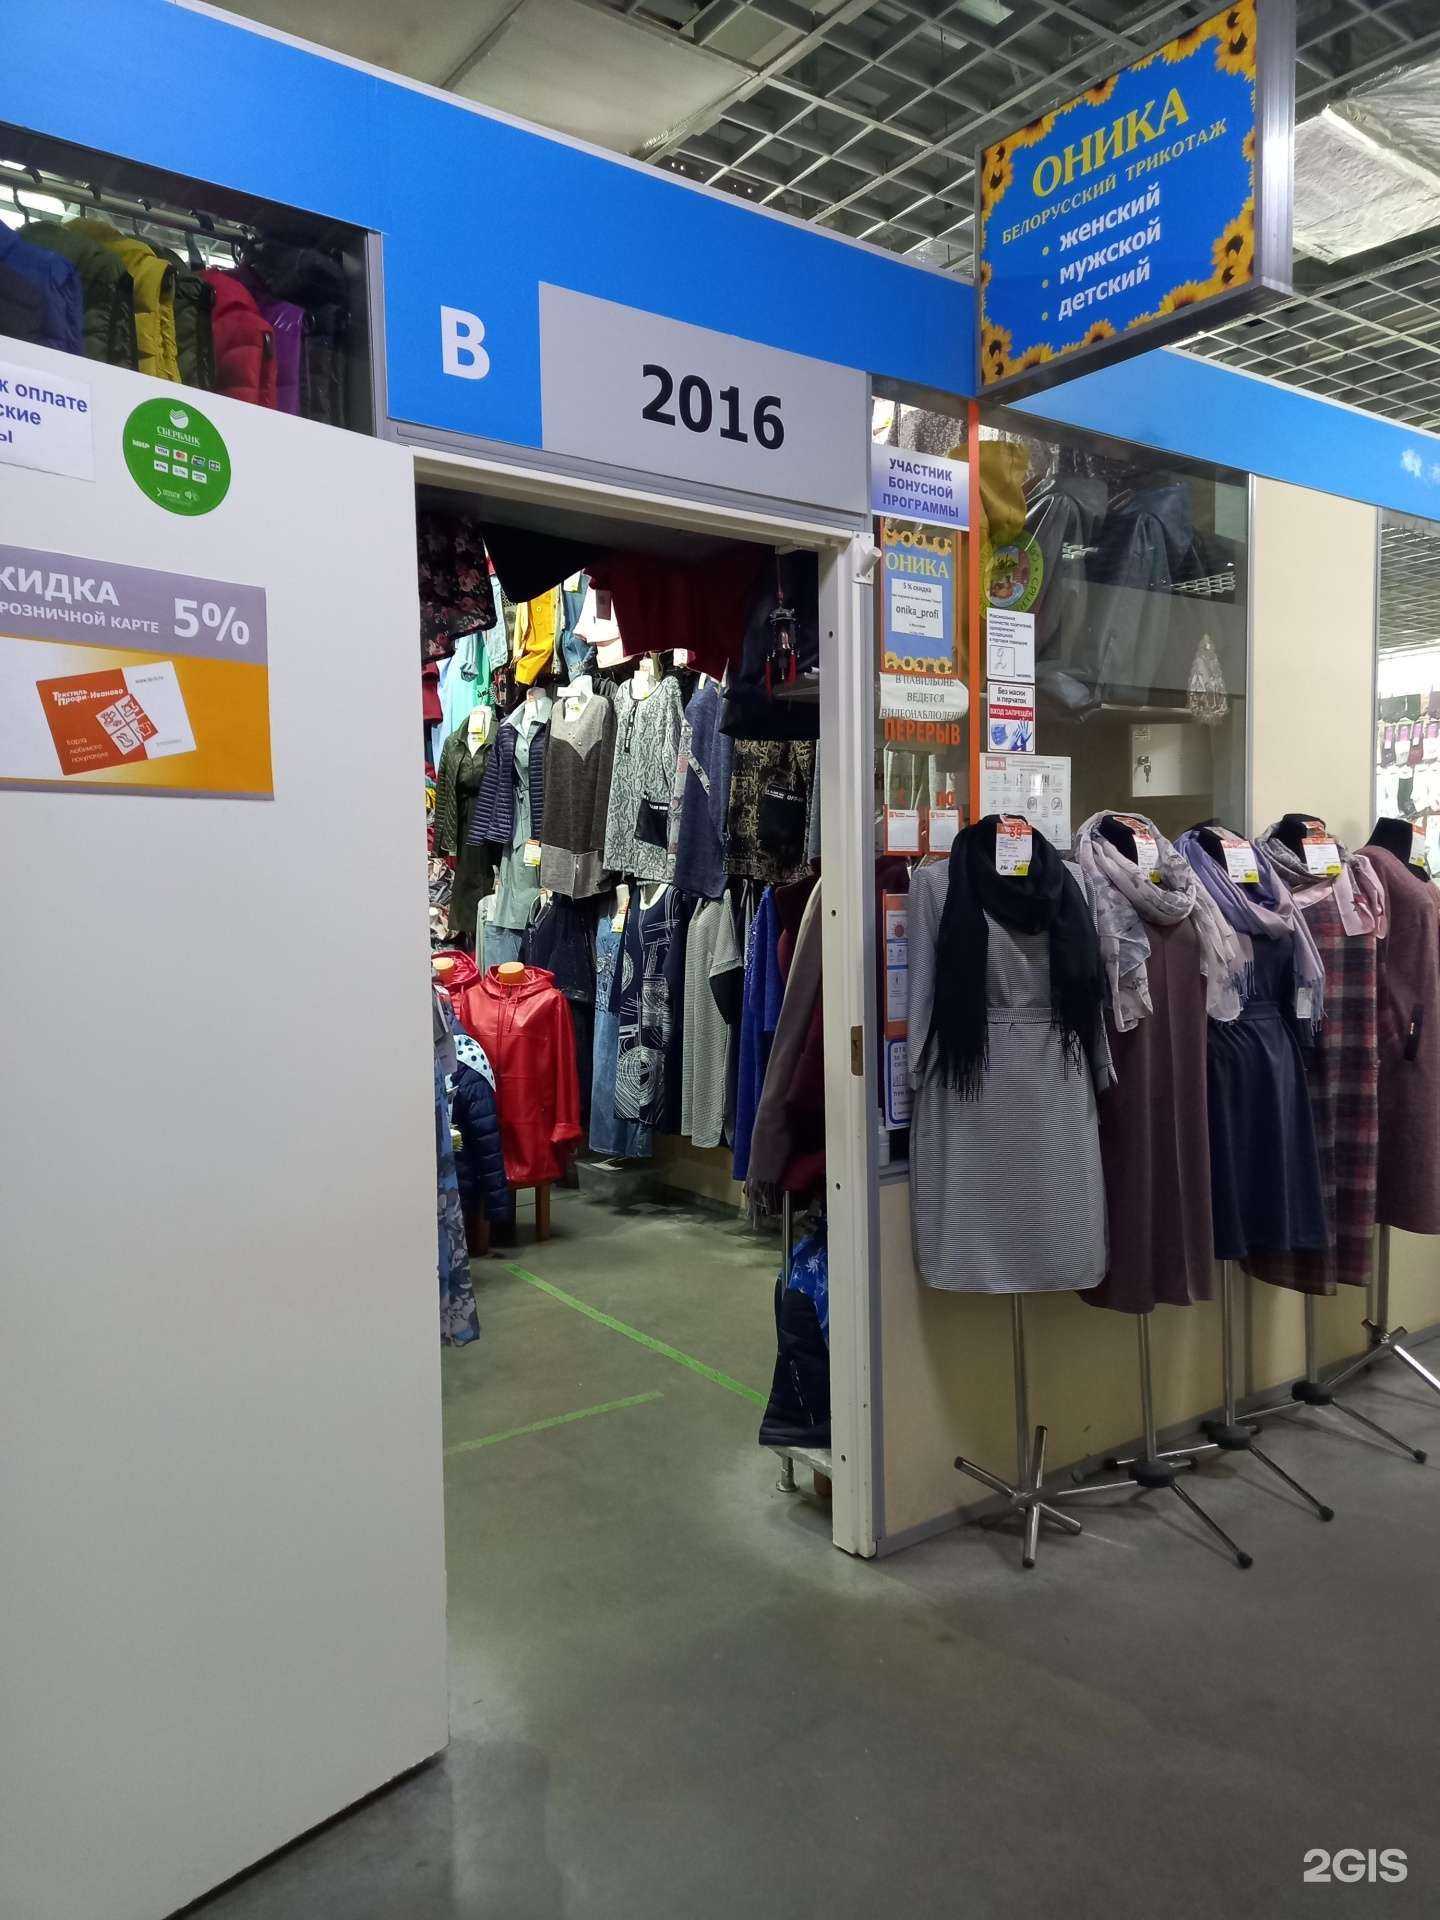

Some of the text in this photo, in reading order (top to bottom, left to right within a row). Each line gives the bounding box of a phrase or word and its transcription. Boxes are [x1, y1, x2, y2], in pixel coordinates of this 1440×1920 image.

[1032, 87, 1189, 198] ОНИКА
[1002, 118, 1227, 246] БЕЛОРУССКИЙ ТРИКОТАЖ
[1058, 183, 1160, 252] женский
[1059, 220, 1161, 285] мужской
[1058, 258, 1150, 321] детский
[15, 383, 88, 413] оплате
[641, 363, 785, 450] 2016
[889, 458, 952, 482] УЧАСТНИК
[888, 476, 953, 500] БОНУСНОЙ
[882, 493, 959, 518] ПРОГРАММЫ
[886, 552, 950, 579] ОНИКА
[110, 616, 159, 634] КАРТЕ
[174, 597, 250, 646] 5%
[896, 604, 939, 620] onika_profi
[907, 692, 944, 704] ВЕДЕТСЯ
[884, 718, 960, 745] ПЕРЕРЫВ
